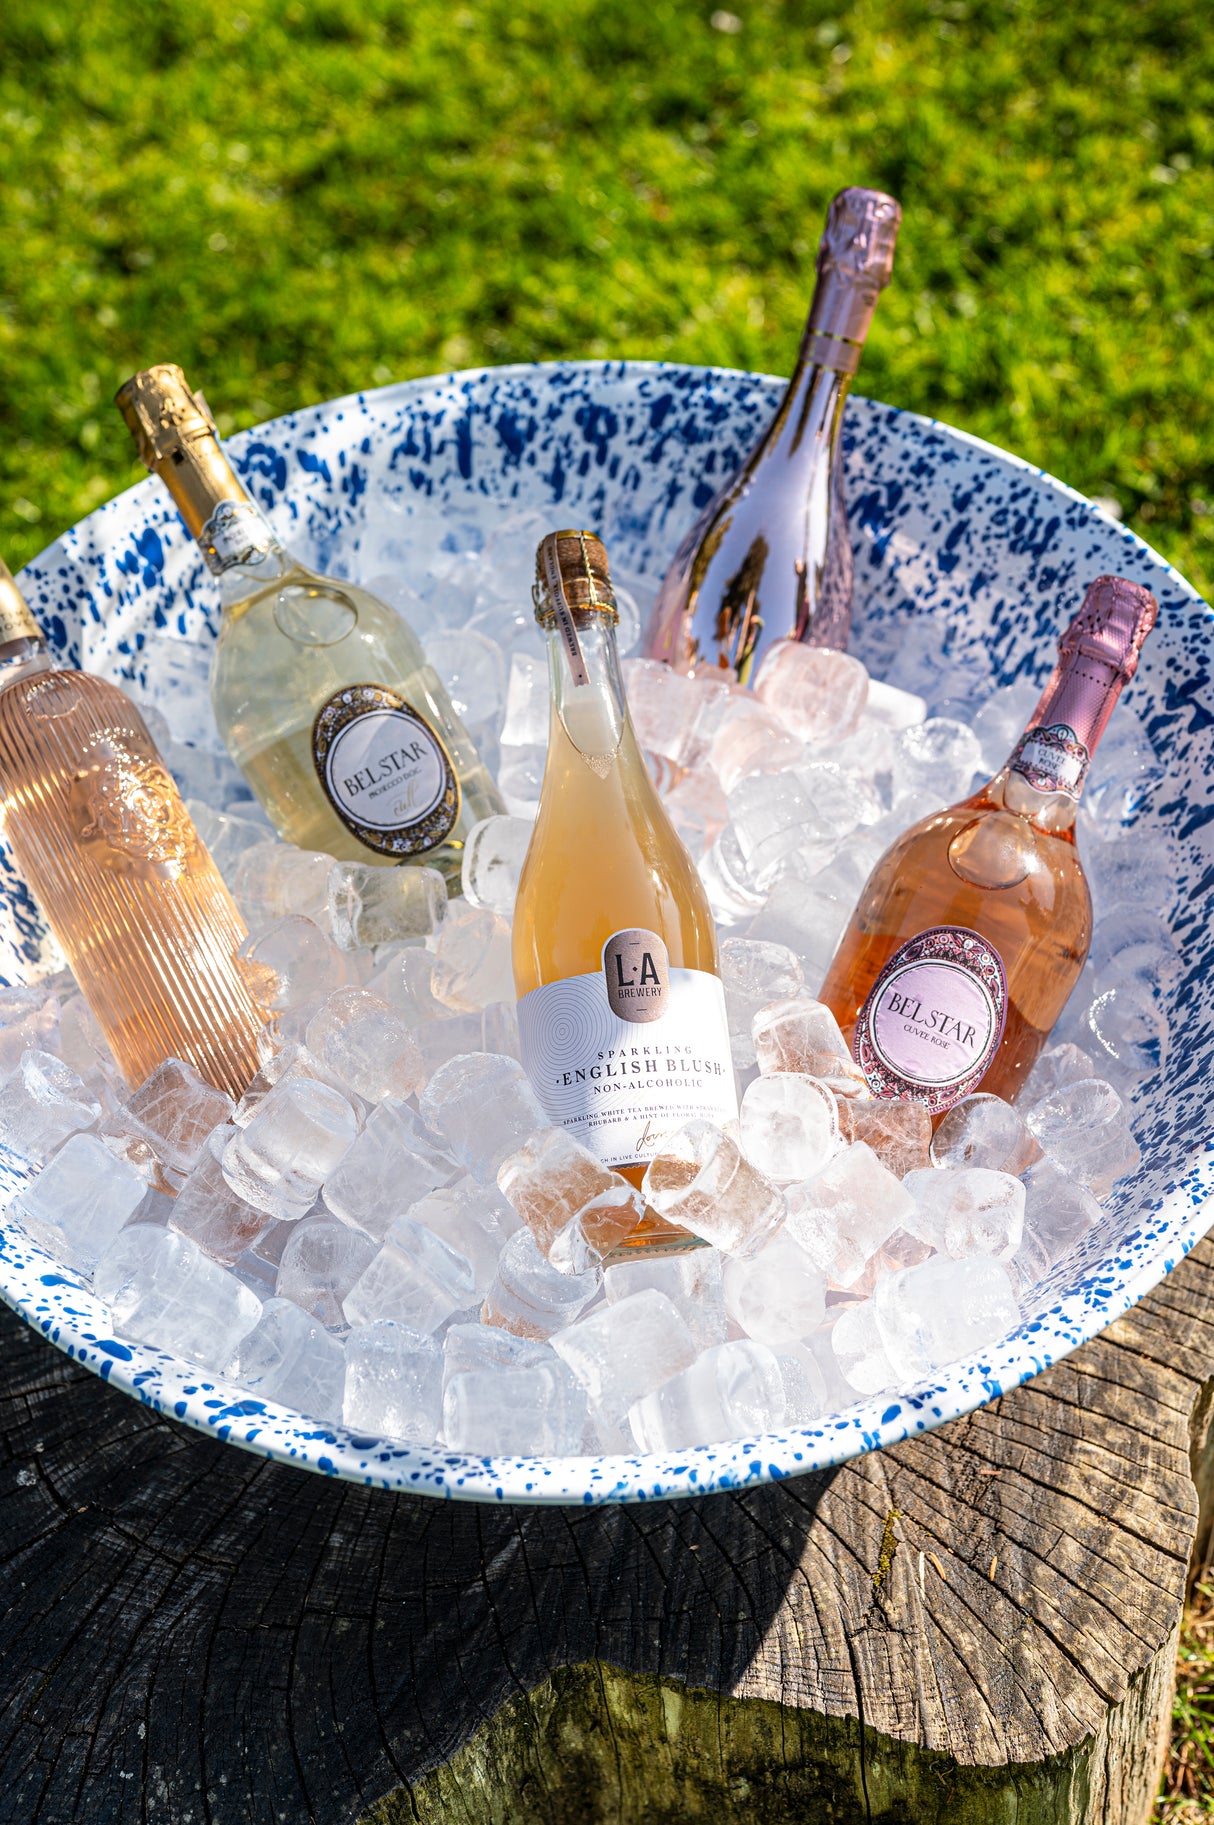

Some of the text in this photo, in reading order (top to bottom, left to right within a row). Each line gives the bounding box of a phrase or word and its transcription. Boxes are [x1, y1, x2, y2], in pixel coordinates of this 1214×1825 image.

[547, 546, 557, 580] ENGLAND
[561, 616, 569, 627] IN
[564, 627, 578, 657] BREWED
[343, 741, 428, 798] BELSTAR
[618, 987, 662, 999] BREWERY
[887, 992, 976, 1049] BELSTAR
[903, 1024, 930, 1041] CUVEE
[597, 1045, 693, 1060] SPARKLING
[593, 1078, 703, 1095] NON-ALCOHOLIC
[563, 1112, 599, 1126] SPARKLING
[600, 1108, 625, 1117] WHITE
[644, 1104, 675, 1112] BREWED
[588, 1116, 622, 1128] RHUBARB
